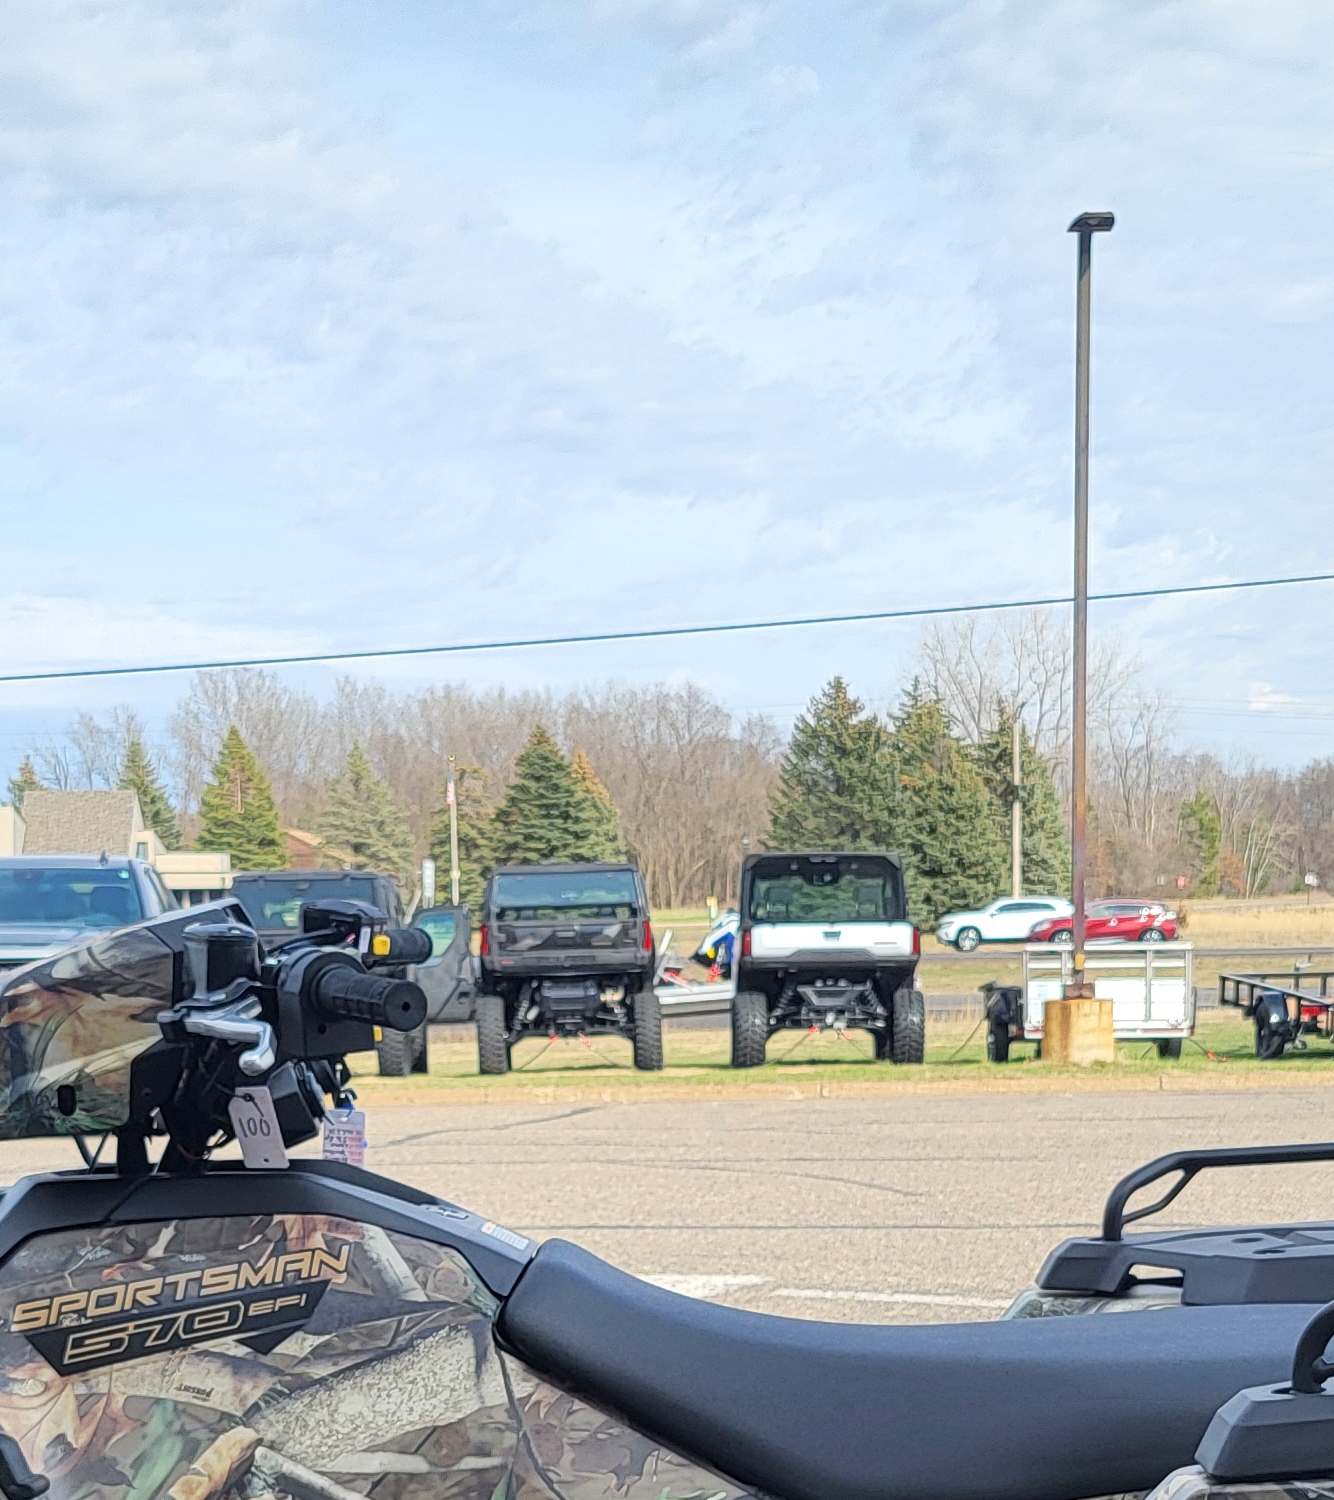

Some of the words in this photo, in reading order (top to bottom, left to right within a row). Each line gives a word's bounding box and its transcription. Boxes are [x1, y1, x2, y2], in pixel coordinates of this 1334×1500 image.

[238, 1116, 271, 1138] 100
[10, 1245, 350, 1332] SPORTSMAN
[63, 1300, 245, 1365] 570
[247, 1294, 308, 1317] EFI
